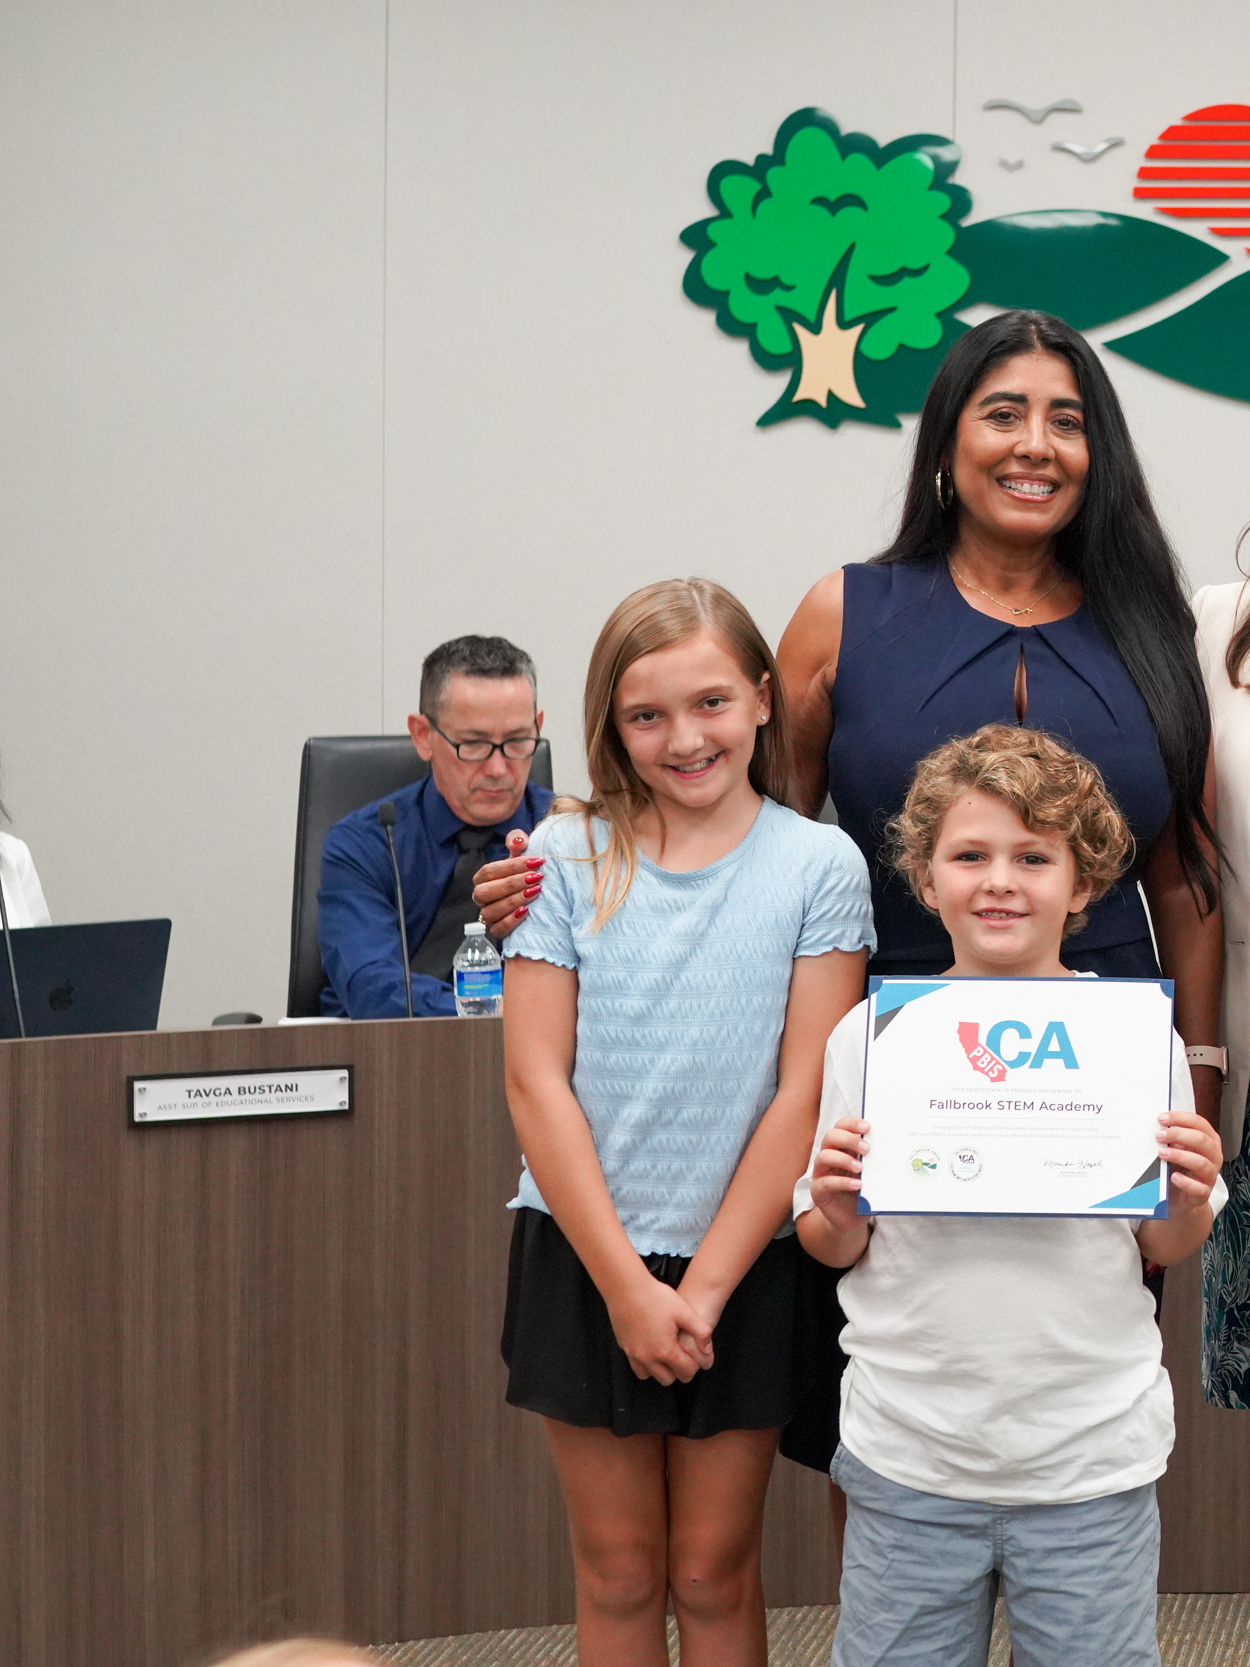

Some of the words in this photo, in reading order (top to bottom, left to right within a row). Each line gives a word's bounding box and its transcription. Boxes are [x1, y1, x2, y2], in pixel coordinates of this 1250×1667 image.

[985, 1020, 1080, 1069] CA
[968, 1045, 1003, 1078] PBIS
[185, 1087, 233, 1099] TAVGA
[237, 1083, 299, 1096] BUSTANI
[215, 1098, 273, 1107] EDUCATIONAL
[275, 1095, 315, 1104] SERVICES
[929, 1099, 993, 1110] Fallbrook
[997, 1100, 1034, 1111] STEM
[1038, 1101, 1104, 1114] Academy
